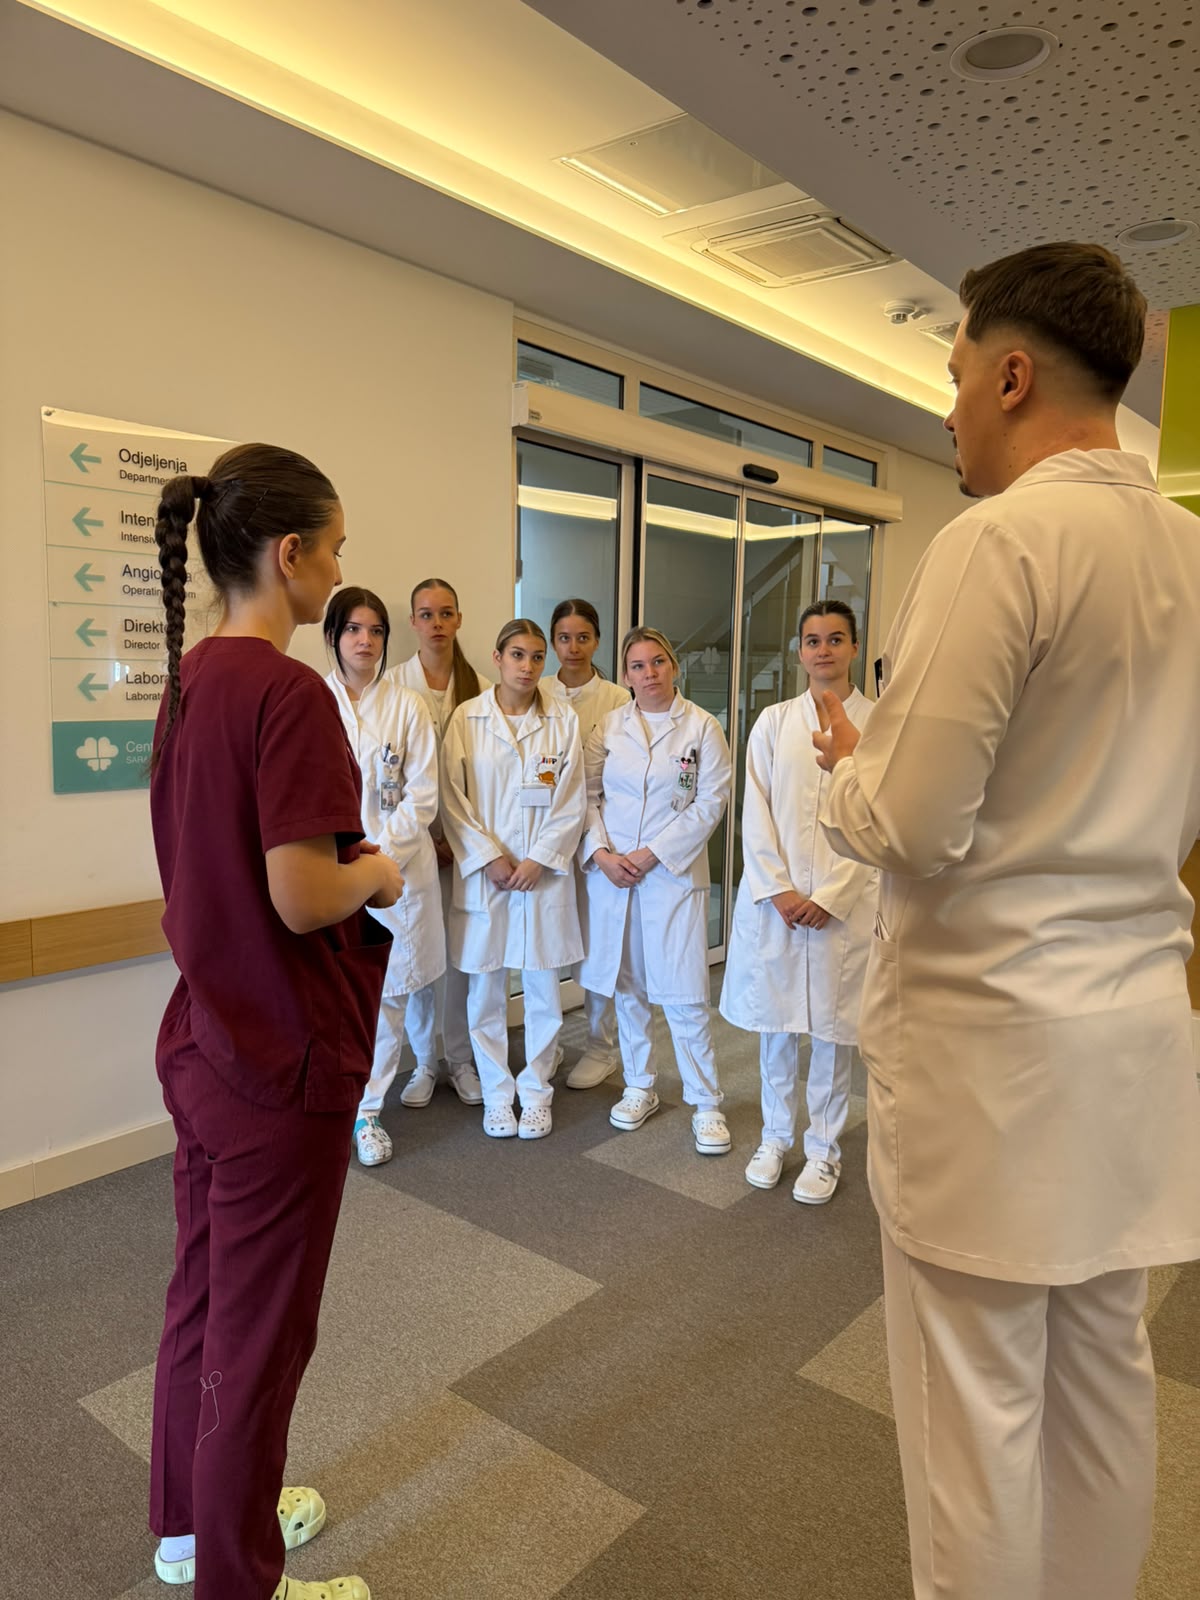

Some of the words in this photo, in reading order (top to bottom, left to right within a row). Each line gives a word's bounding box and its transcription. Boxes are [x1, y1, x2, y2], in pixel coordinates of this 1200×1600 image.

[119, 448, 187, 474] Odjeljenja
[120, 510, 158, 527] Inten
[122, 564, 161, 582] Angio
[122, 584, 163, 597] Operatin
[124, 639, 161, 650] Director
[125, 740, 153, 753] Cen
